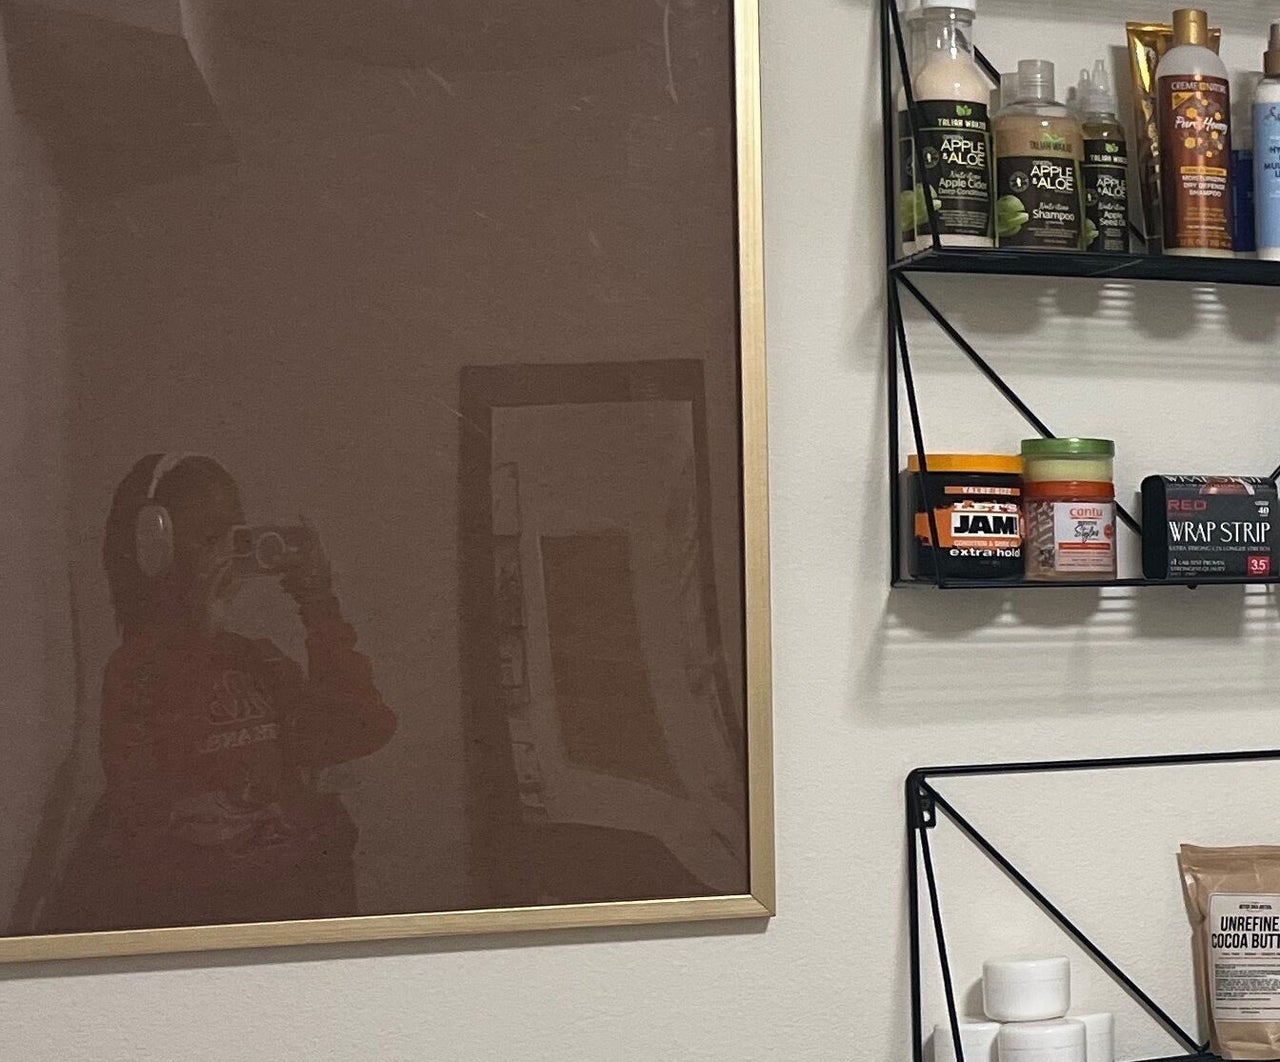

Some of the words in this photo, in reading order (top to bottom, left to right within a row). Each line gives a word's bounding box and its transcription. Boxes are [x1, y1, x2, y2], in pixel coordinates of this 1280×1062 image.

[941, 140, 985, 153] APPLE
[947, 152, 986, 167] ALOE
[1030, 165, 1073, 179] APPLE
[939, 178, 966, 188] Apple
[1037, 177, 1074, 191] ALOE
[1032, 209, 1075, 221] Shampoo
[1168, 499, 1208, 511] RED
[1069, 507, 1103, 518] cantu
[1168, 521, 1217, 543] WRAP
[1219, 521, 1271, 543] STRIP
[949, 549, 993, 557] extra
[996, 548, 1021, 558] hold
[1211, 933, 1248, 949] COCOA
